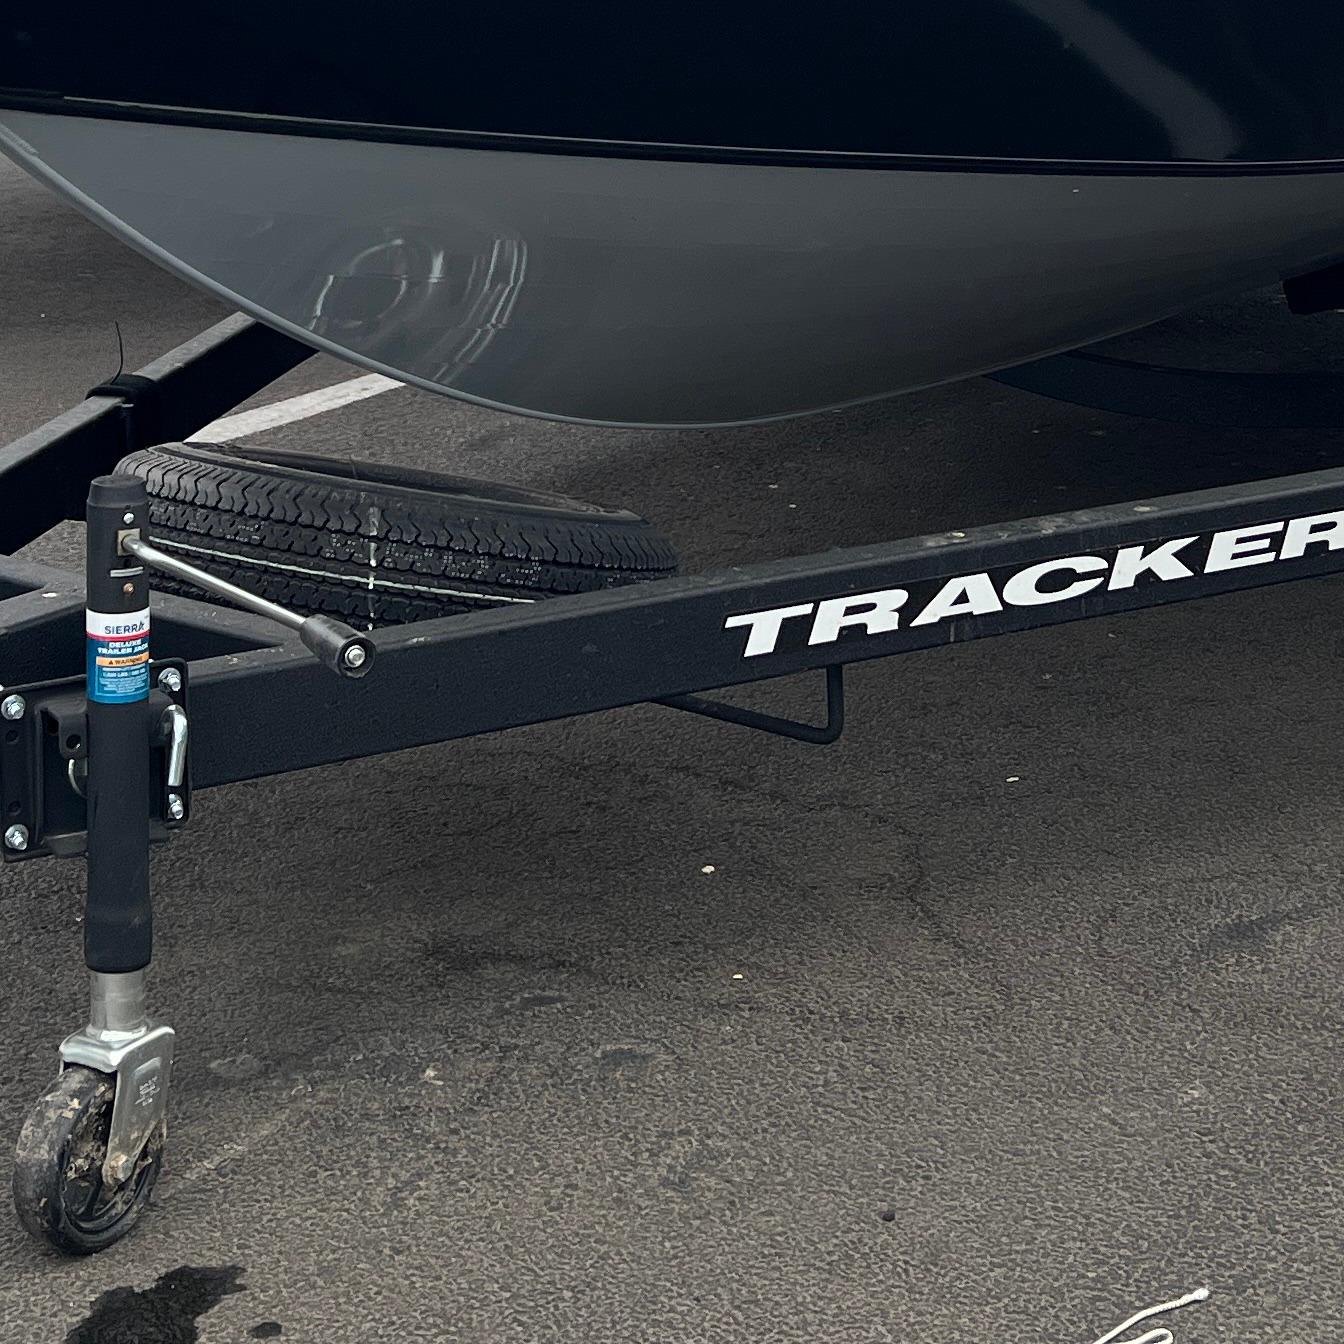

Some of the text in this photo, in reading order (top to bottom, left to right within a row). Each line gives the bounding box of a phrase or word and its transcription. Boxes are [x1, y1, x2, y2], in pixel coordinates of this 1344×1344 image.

[104, 620, 145, 635] SIERRA
[109, 640, 142, 648] DELUXE
[97, 646, 133, 655] TRAILER
